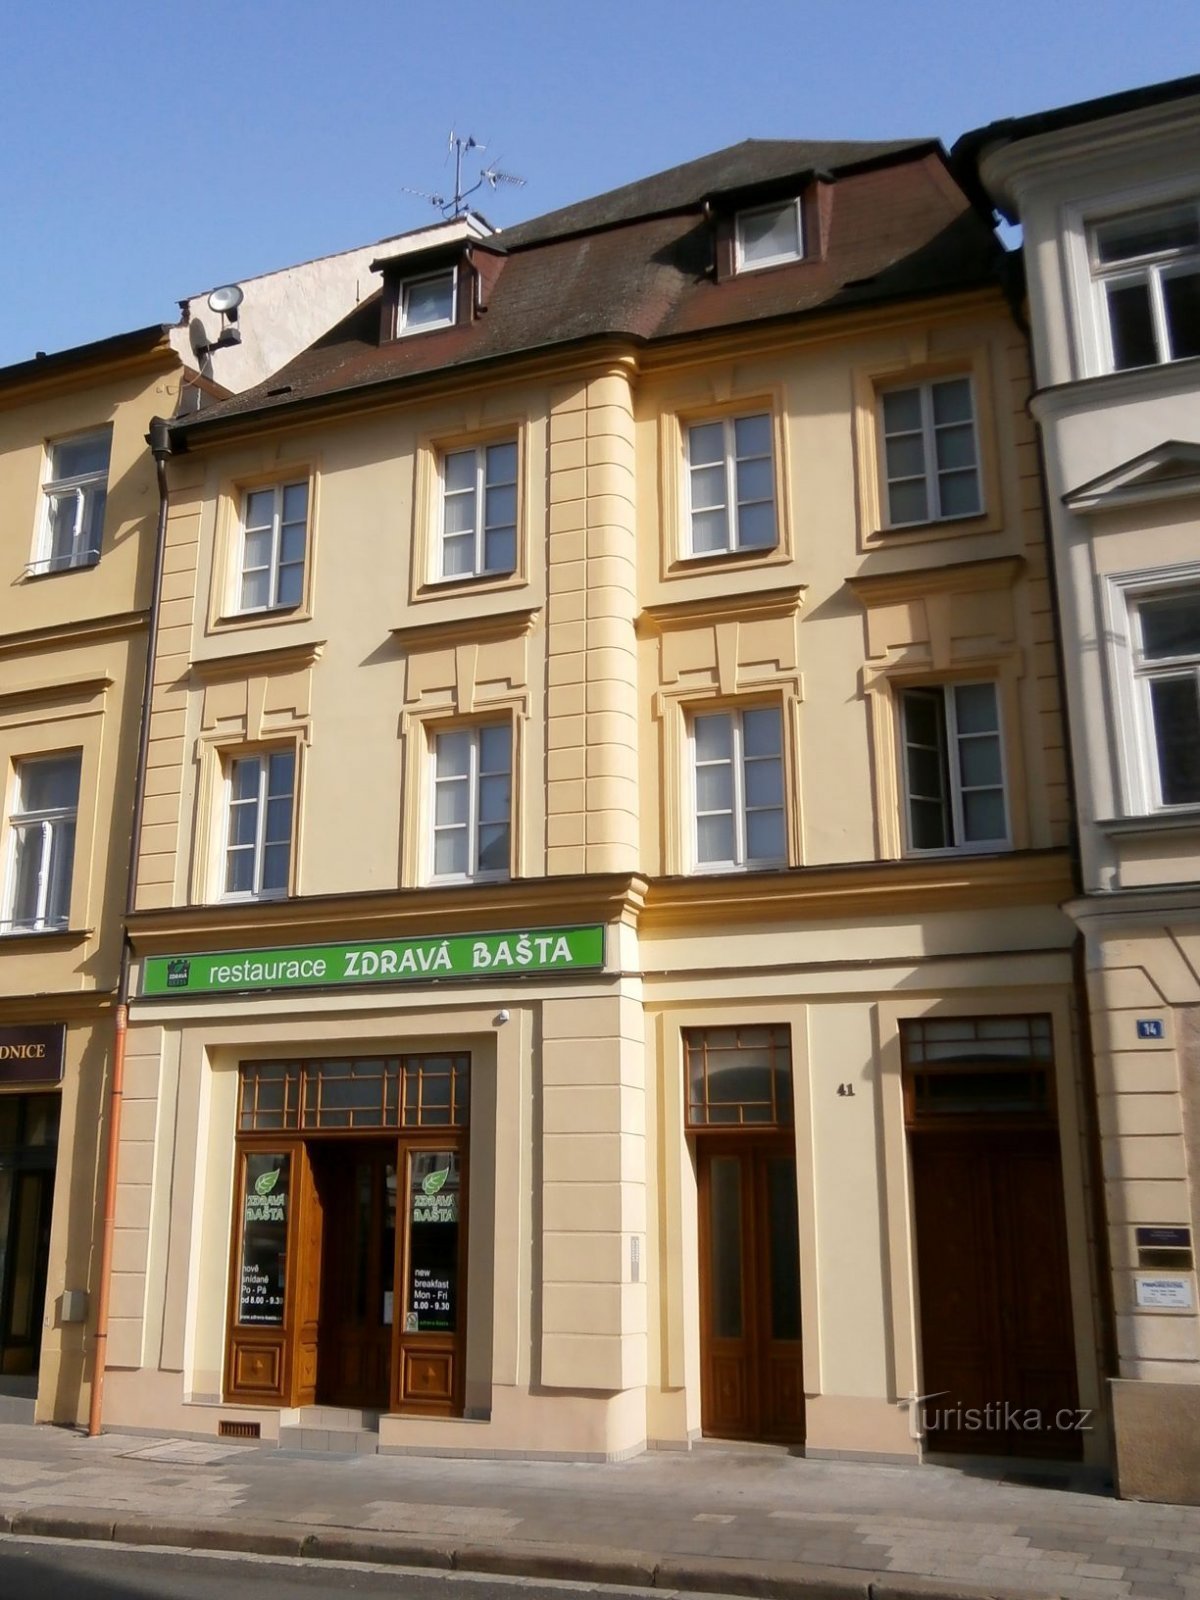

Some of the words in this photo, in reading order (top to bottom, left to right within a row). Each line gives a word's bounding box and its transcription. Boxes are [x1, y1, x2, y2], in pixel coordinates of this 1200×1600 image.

[209, 958, 327, 984] restaurace
[343, 940, 453, 977] ZDRAVÁ
[472, 933, 574, 968] BAŠTA
[1143, 1022, 1157, 1036] 14
[0, 1043, 46, 1060] DNICE
[836, 1082, 856, 1097] 41
[414, 1269, 431, 1277] new
[414, 1279, 449, 1289] breakfast
[414, 1290, 431, 1299] Mon
[437, 1290, 448, 1300] Fri
[413, 1301, 429, 1310] 8.00
[434, 1301, 450, 1311] 9.30
